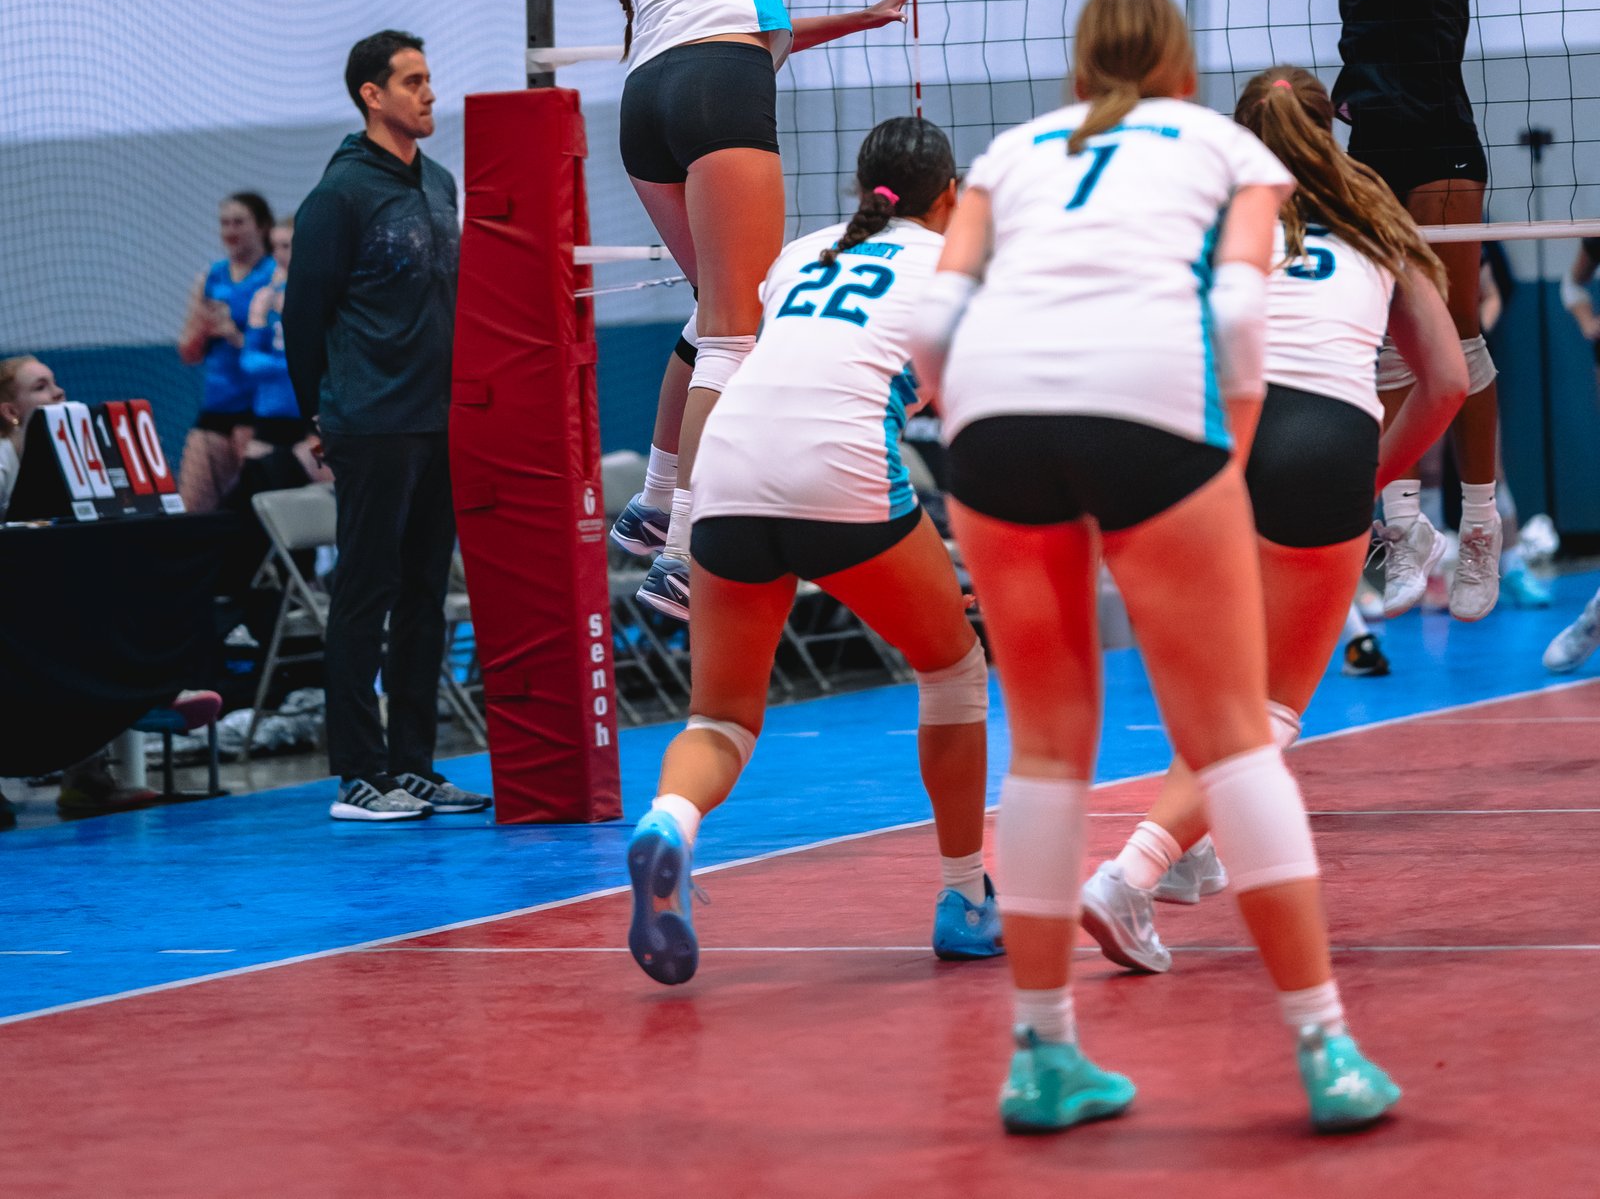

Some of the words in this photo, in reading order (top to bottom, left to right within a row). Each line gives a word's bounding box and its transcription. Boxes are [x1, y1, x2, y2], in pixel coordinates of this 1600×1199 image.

[1065, 143, 1120, 211] 7
[776, 261, 896, 328] 22
[57, 418, 108, 486] 14
[117, 409, 167, 484] 10
[587, 613, 610, 747] senoh
